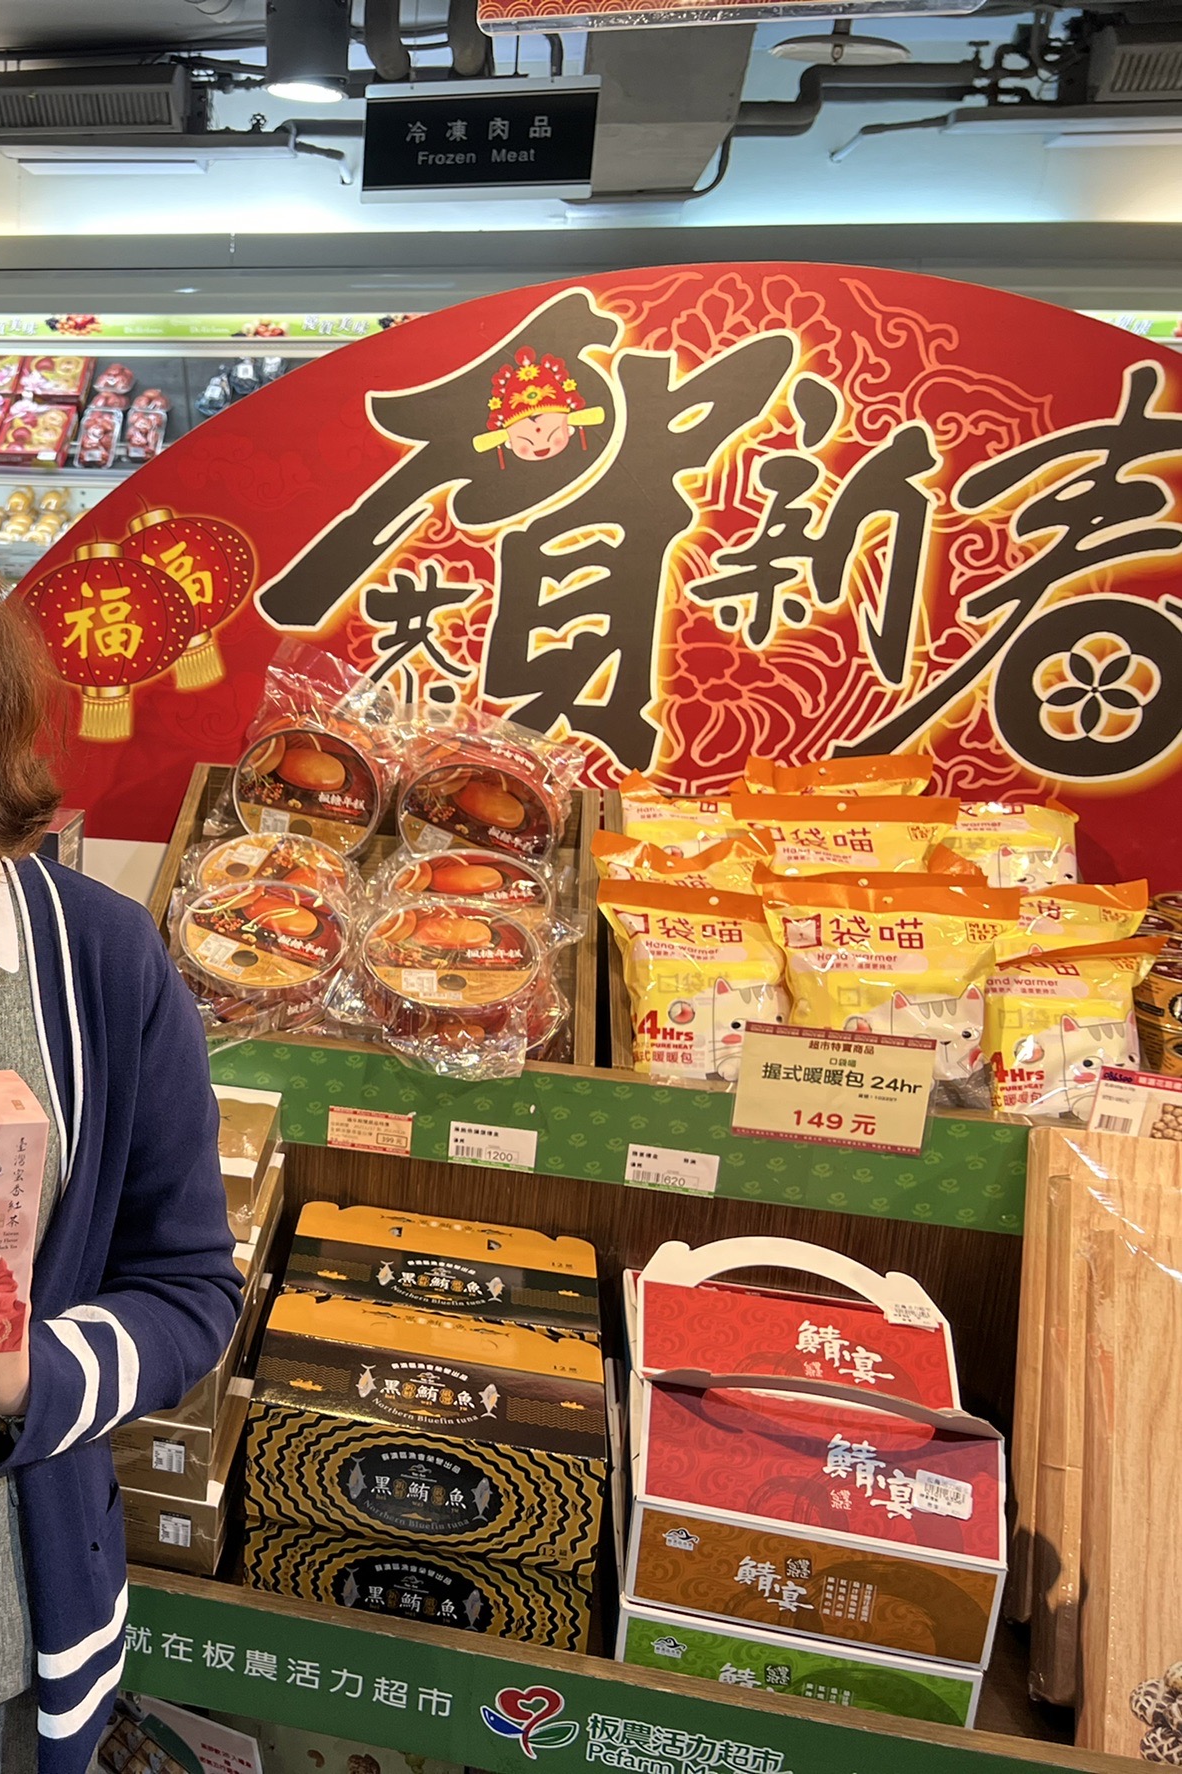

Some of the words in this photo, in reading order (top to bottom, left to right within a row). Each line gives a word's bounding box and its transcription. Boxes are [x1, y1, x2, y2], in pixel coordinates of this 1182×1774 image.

[405, 115, 553, 144] 冷凍肉品
[417, 150, 477, 166] Frozen
[490, 148, 536, 164] Meat
[62, 582, 144, 660] 福
[986, 977, 1011, 986] and
[1013, 978, 1059, 987] warmer
[635, 1010, 694, 1042] 4Hrs
[650, 1042, 672, 1050] PURE
[761, 1062, 865, 1089] 握式暖暖包
[870, 1075, 923, 1095] 24hr
[990, 1051, 1045, 1083] 4Hrs
[999, 1085, 1023, 1093] PURE
[793, 1109, 844, 1131] 149
[850, 1113, 877, 1136] 元
[486, 1150, 514, 1163] 1200
[663, 1175, 686, 1188] 620
[390, 1284, 430, 1304] Northern
[431, 1297, 465, 1307] Bluefin
[466, 1298, 487, 1307] tuna
[397, 1271, 484, 1296] 黑鮪魚
[795, 1319, 896, 1385] 鯖宴
[379, 1378, 476, 1410] 黑鮪魚
[372, 1397, 415, 1420] Northern
[417, 1414, 455, 1425] Bluefin
[456, 1414, 479, 1424] tuna
[370, 1475, 467, 1510] 黑鮪魚
[822, 1433, 915, 1520] 鯖宴
[363, 1499, 406, 1526] Northern
[408, 1519, 446, 1531] Bluefin
[447, 1518, 470, 1530] tuna
[733, 1555, 816, 1613] 鯖宴
[364, 1585, 458, 1620] 黑鮪魚
[124, 1623, 454, 1718] 就在板農活力超市
[586, 1712, 786, 1774] 板農活力超市
[586, 1740, 674, 1774] Pcfarm
